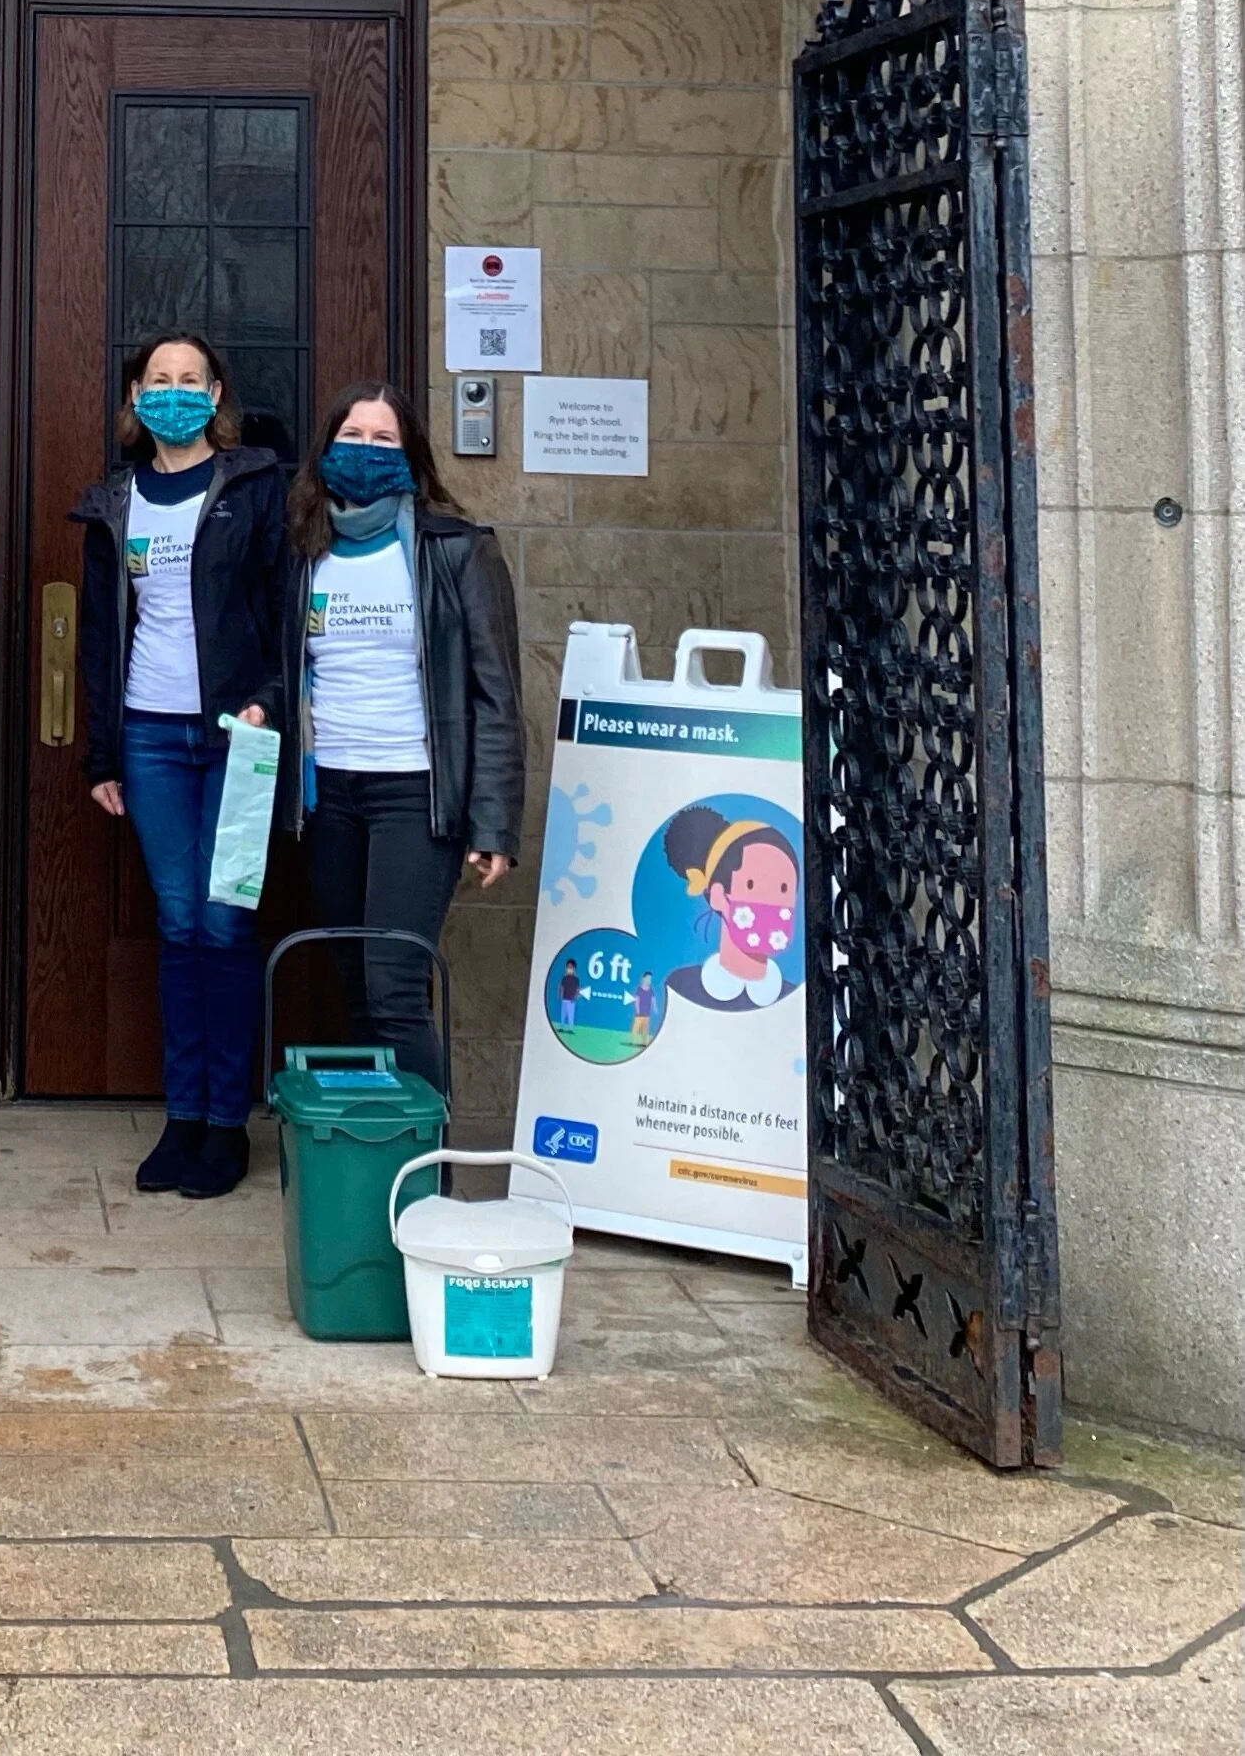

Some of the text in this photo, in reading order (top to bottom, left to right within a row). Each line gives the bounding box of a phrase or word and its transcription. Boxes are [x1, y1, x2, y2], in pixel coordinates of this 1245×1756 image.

[558, 402, 614, 412] Welcome to
[549, 415, 565, 425] Rye
[568, 416, 588, 426] High
[533, 431, 639, 443] Ring the bell in order to
[543, 447, 630, 459] access the building.
[153, 535, 173, 545] RYE
[331, 593, 350, 602] RYE
[329, 604, 413, 615] SUSTAINABILITY
[328, 616, 393, 627] COMMITTEE
[584, 712, 739, 743] Please wear a mask.
[587, 950, 632, 984] 6 ft
[637, 1094, 798, 1131] Maintain a distance of 6 feet
[636, 1114, 744, 1143] whenever possible.
[569, 1134, 592, 1148] CDC
[677, 1167, 759, 1187] cdc.gov/coronavirus
[449, 1277, 529, 1288] FOOD SCRAPS
